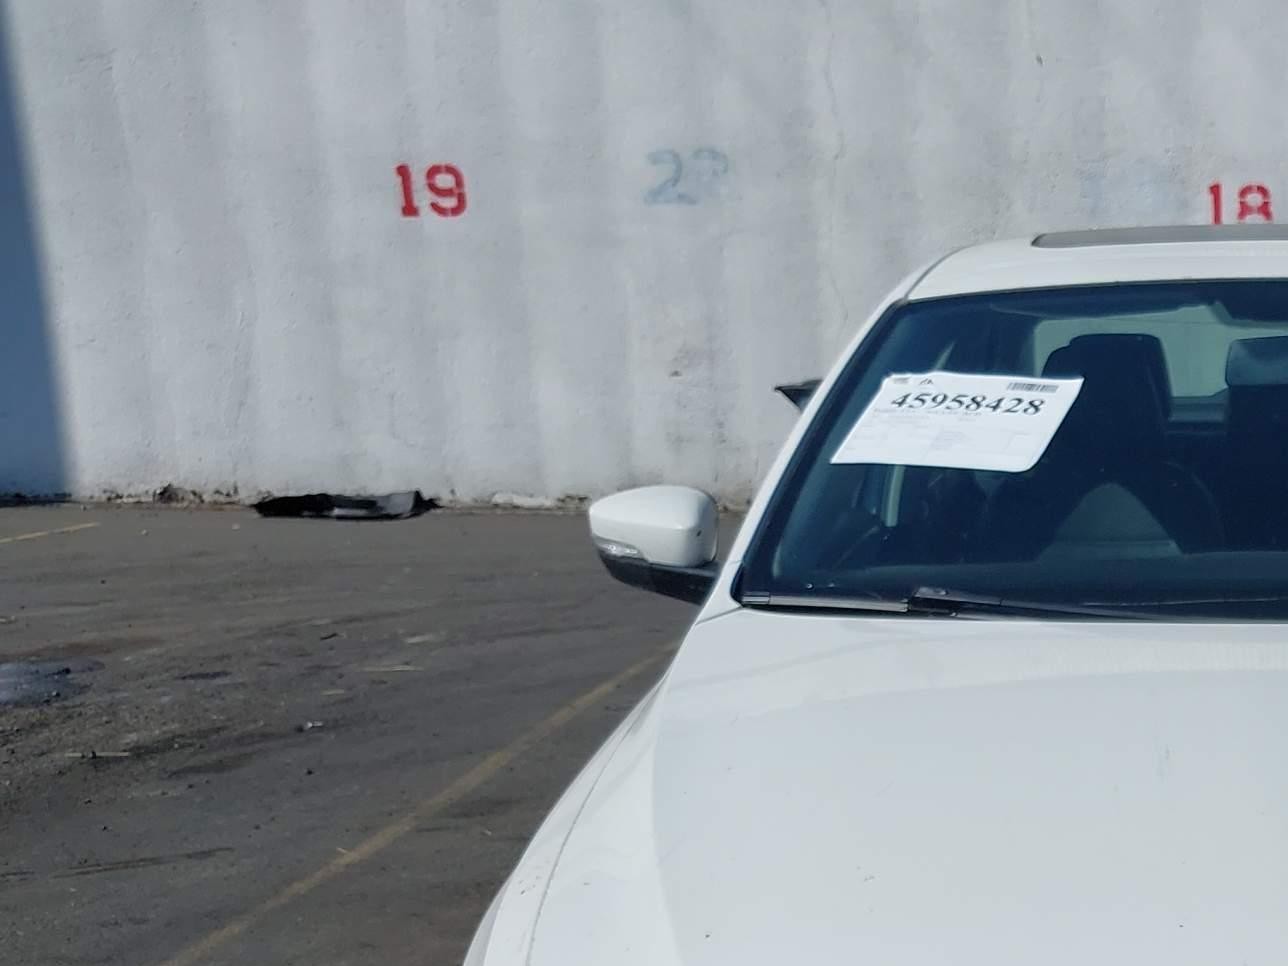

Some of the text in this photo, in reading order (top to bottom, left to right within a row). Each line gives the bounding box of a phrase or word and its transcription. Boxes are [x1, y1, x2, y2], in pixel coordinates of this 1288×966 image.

[396, 163, 467, 217] 19
[1208, 183, 1273, 225] 18
[891, 392, 1045, 416] 45958428
